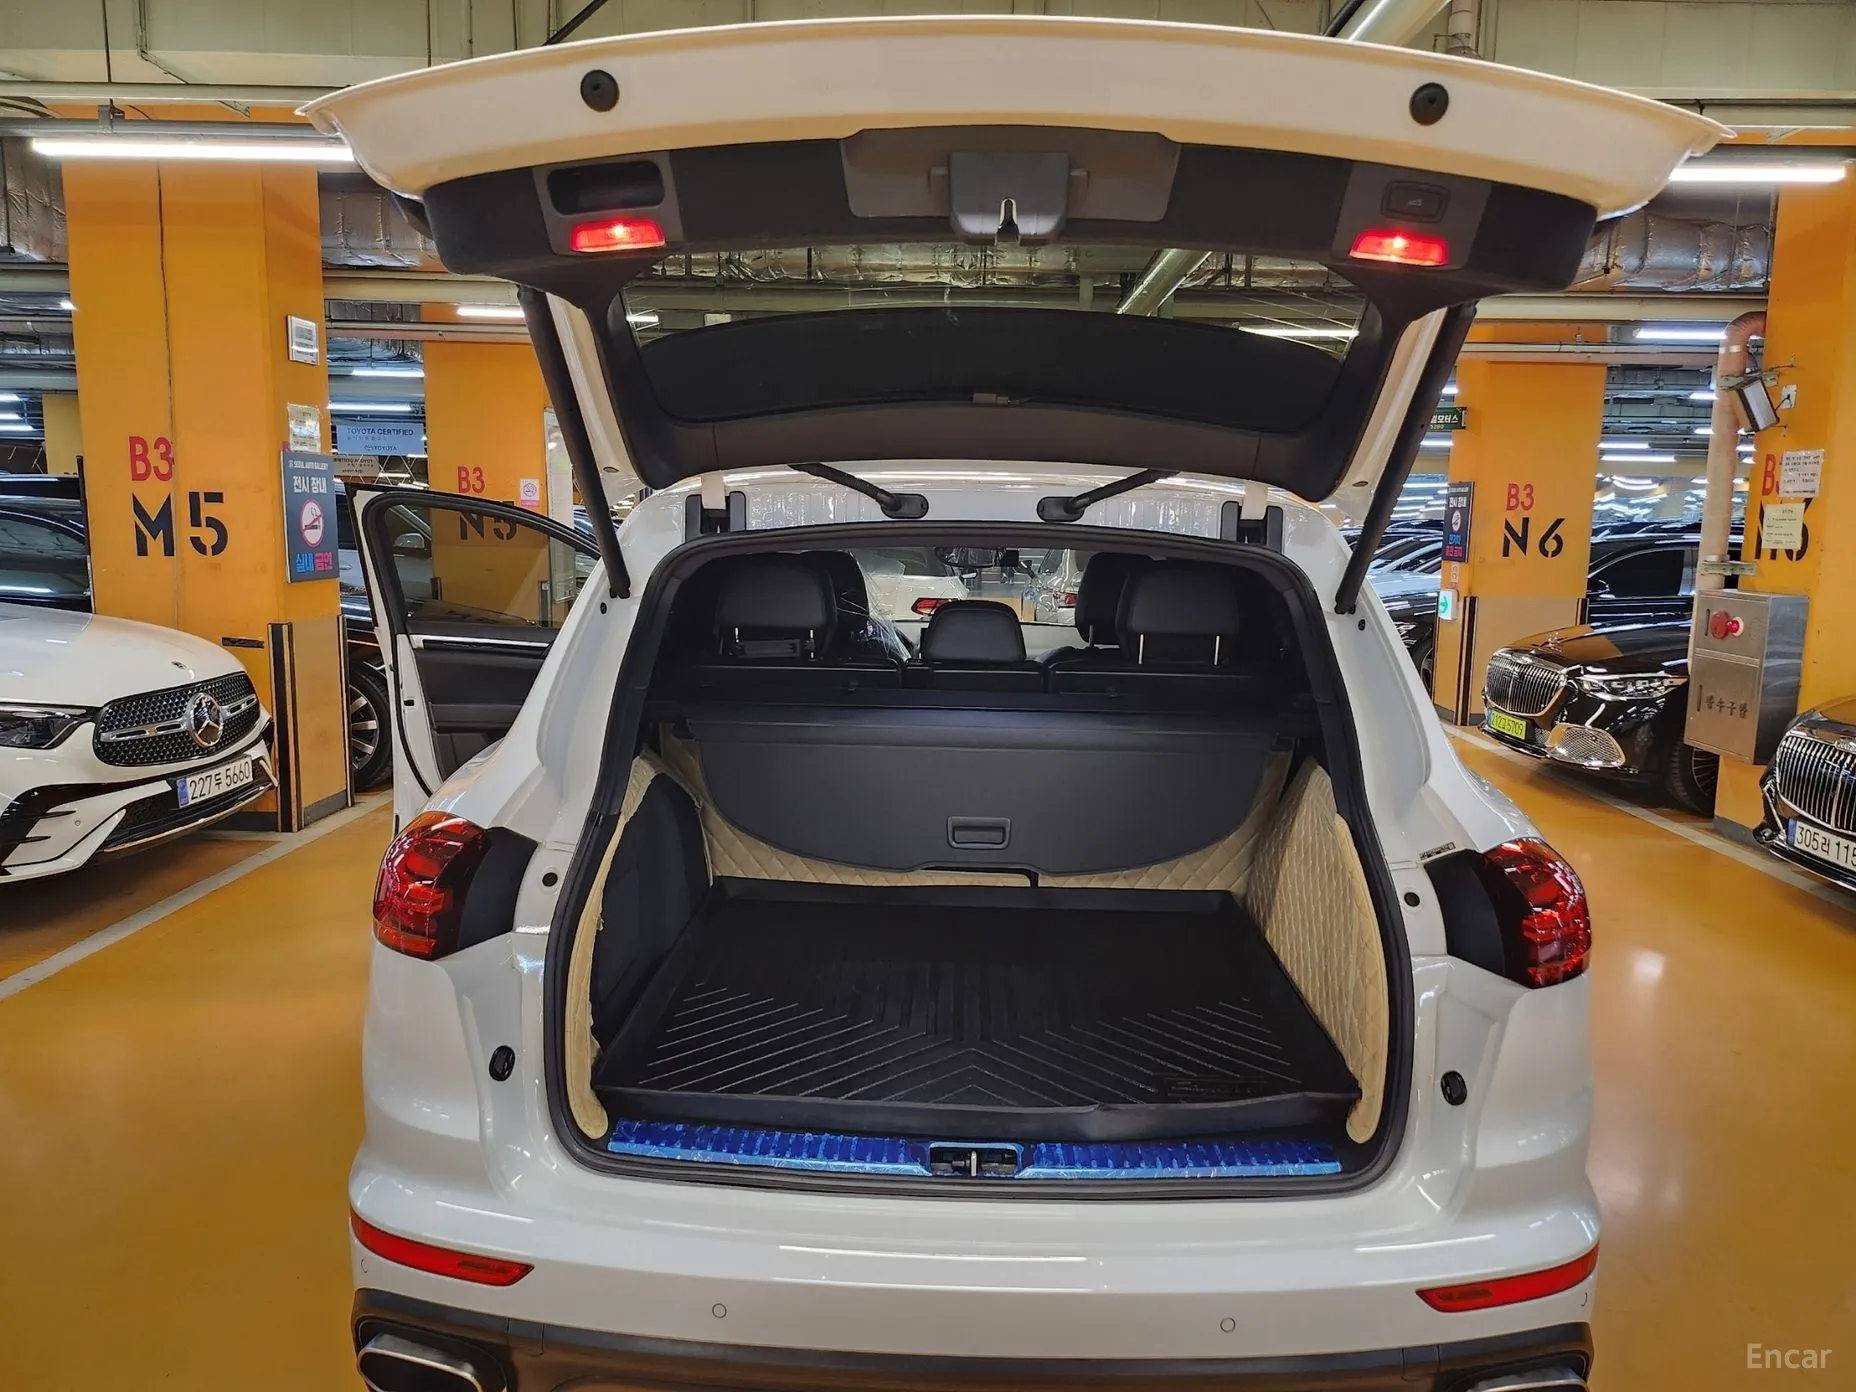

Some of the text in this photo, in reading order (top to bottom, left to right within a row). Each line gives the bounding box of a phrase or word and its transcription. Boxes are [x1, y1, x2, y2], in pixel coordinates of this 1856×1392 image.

[347, 427, 414, 436] TOYOTA CERTIFIED
[129, 436, 174, 481] B3
[293, 475, 327, 494] 전시 장내
[457, 466, 485, 494] B3
[1505, 484, 1534, 511] B3
[296, 552, 333, 573] 실내 금연
[189, 760, 251, 801] 227두 5660
